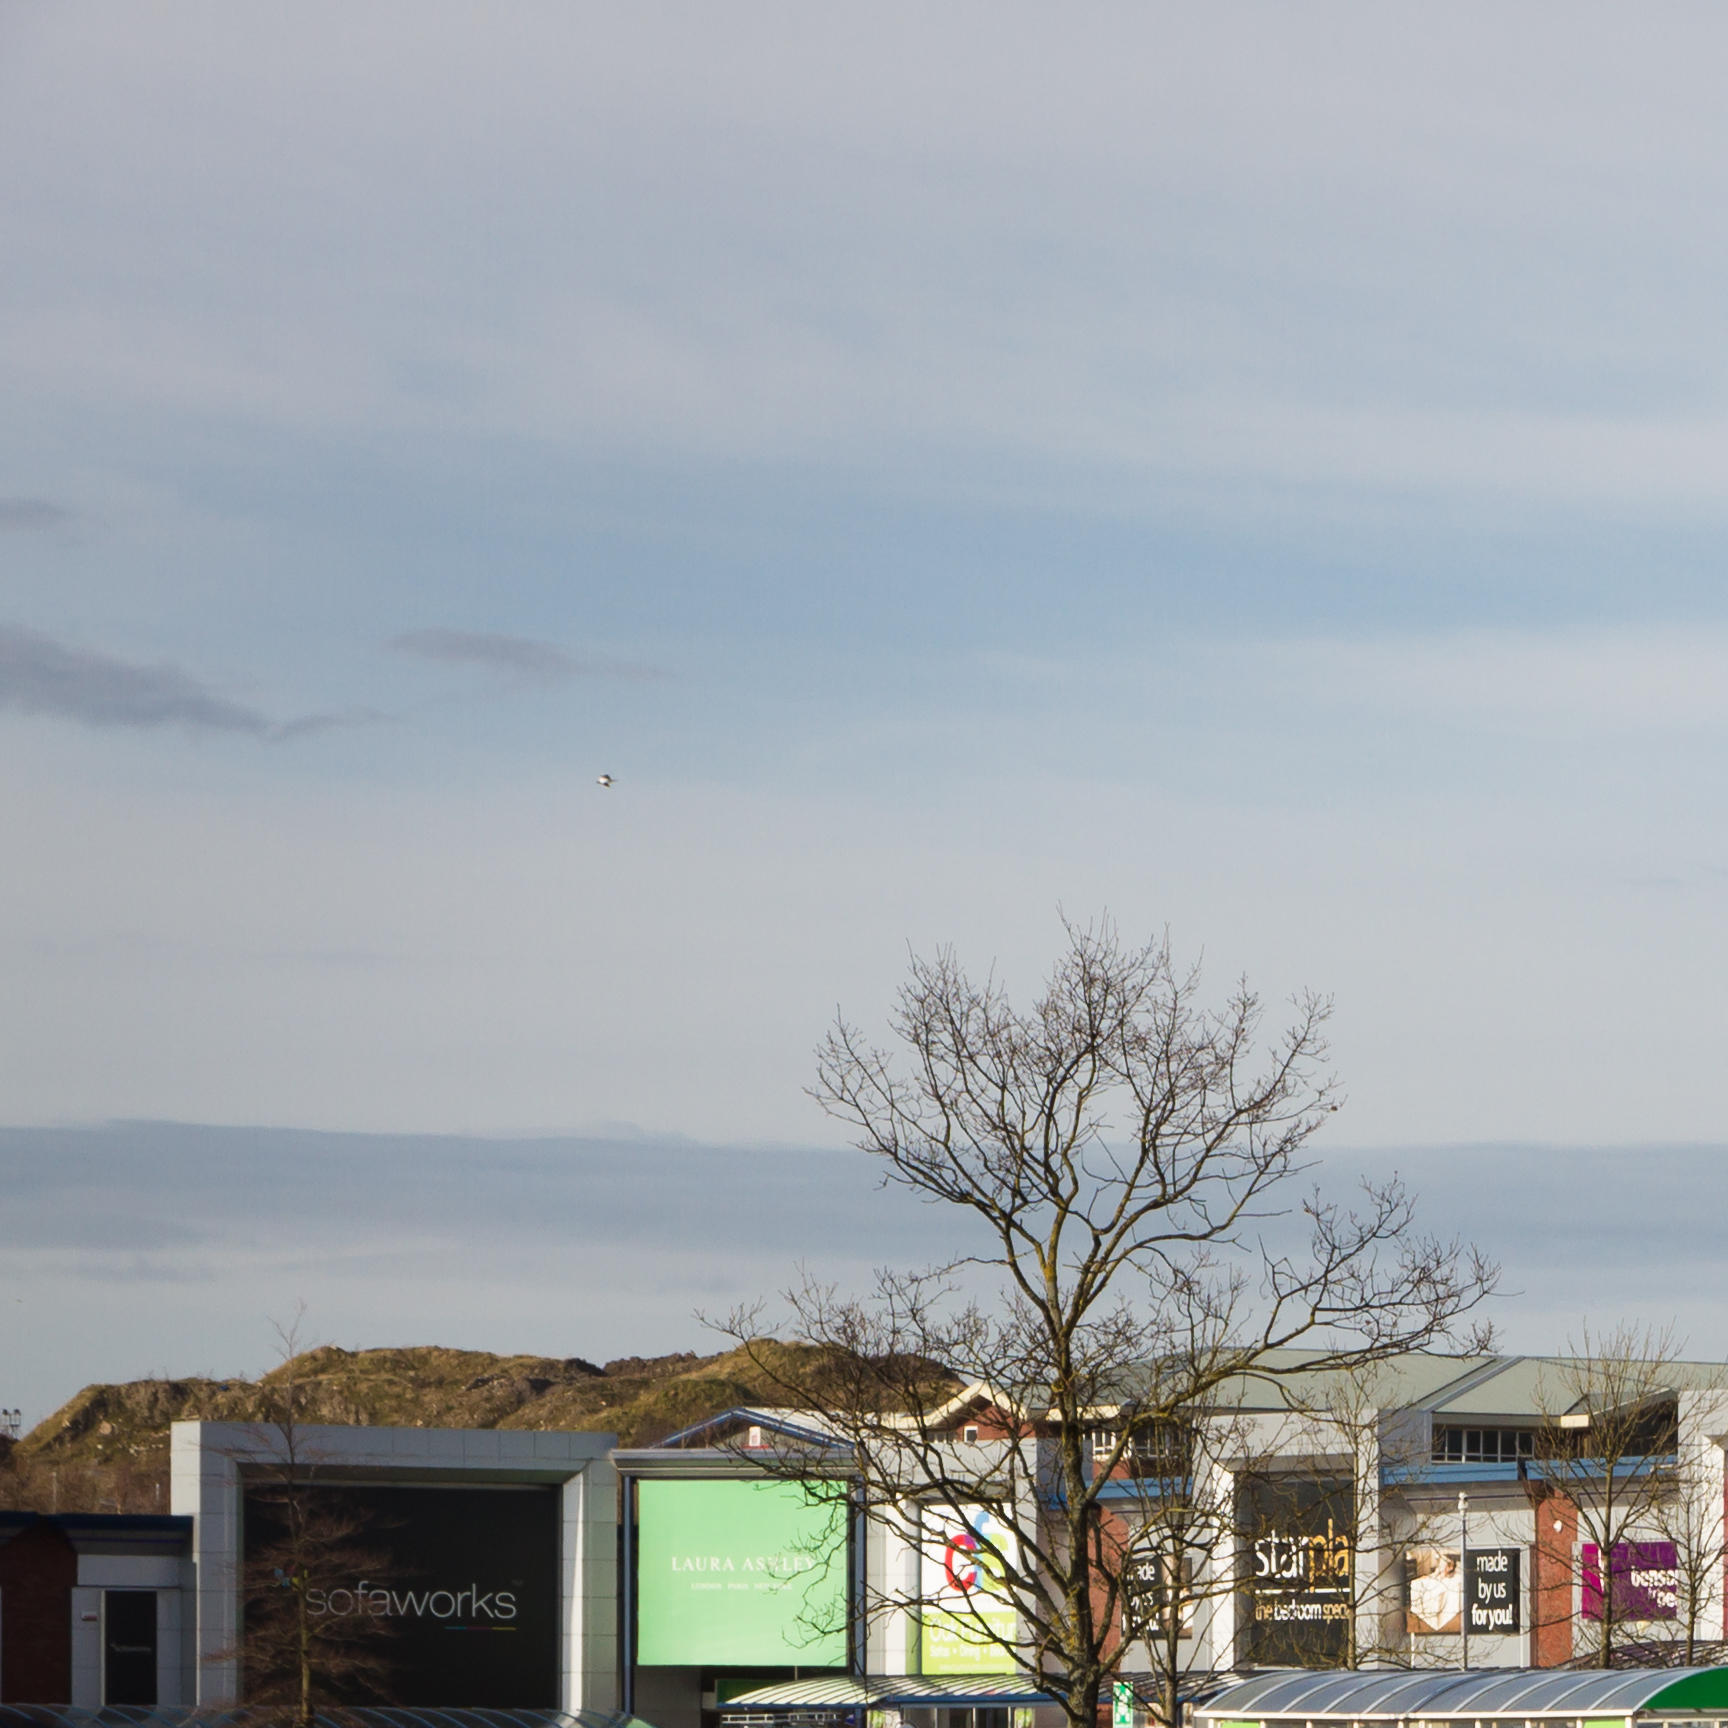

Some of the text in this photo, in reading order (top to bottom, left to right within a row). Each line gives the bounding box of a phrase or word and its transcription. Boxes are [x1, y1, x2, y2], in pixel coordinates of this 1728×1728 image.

[672, 1556, 734, 1572] LAURA
[1476, 1550, 1508, 1572] made
[305, 1580, 517, 1619] sofaworks
[1478, 1577, 1507, 1604] by us
[1472, 1603, 1513, 1630] for you!
